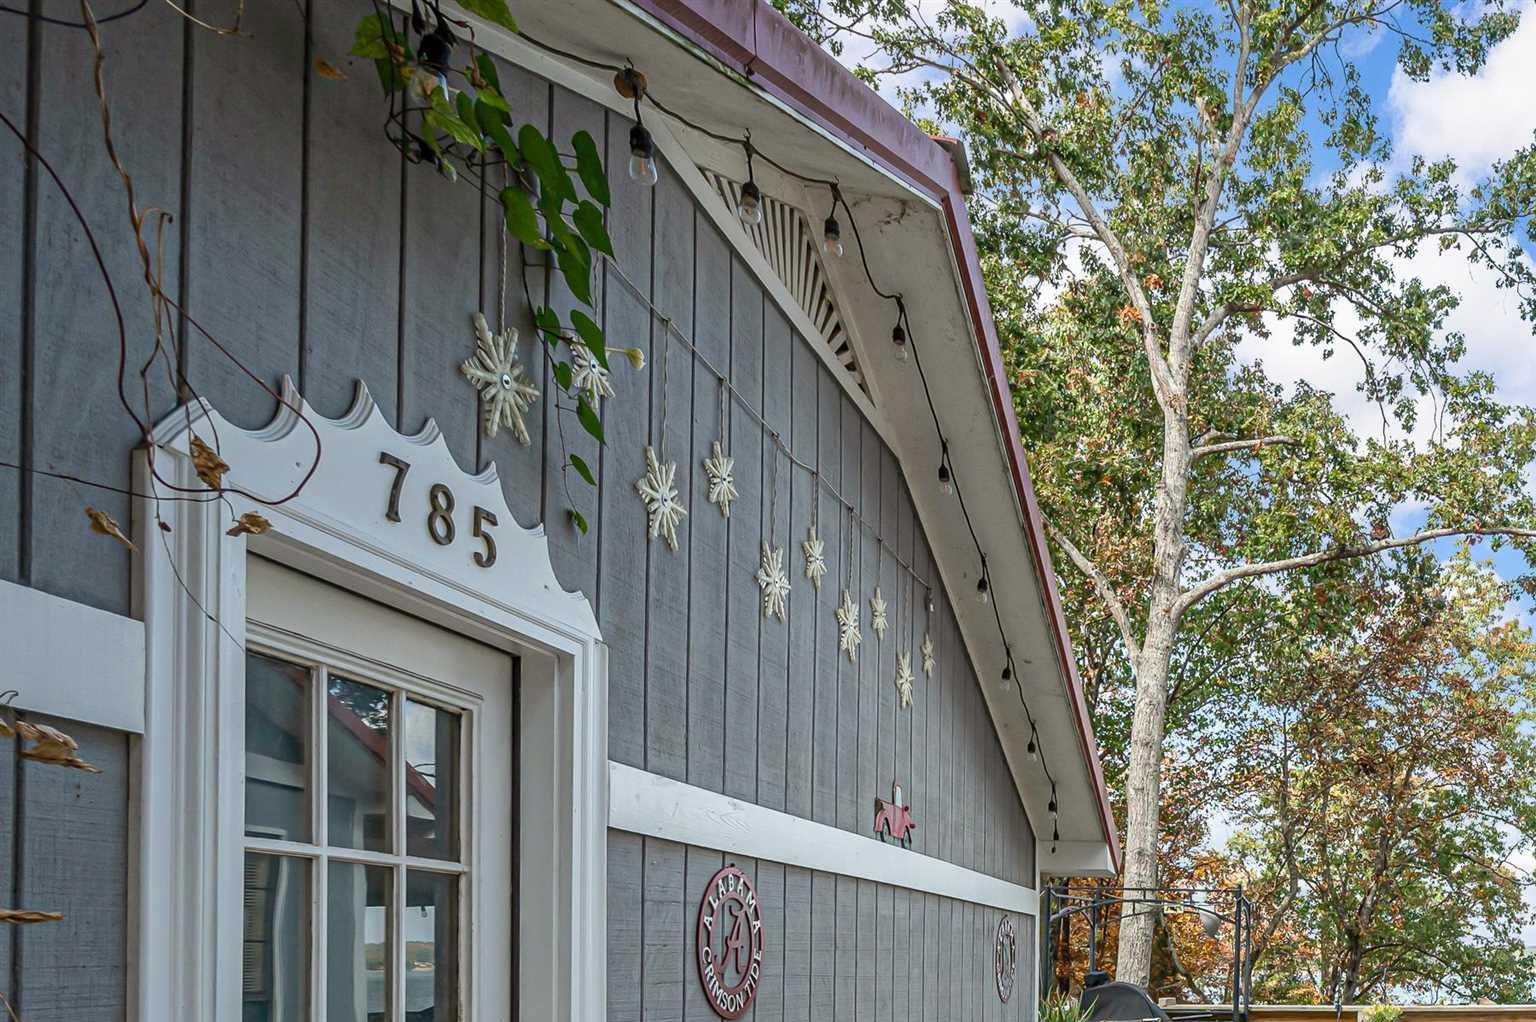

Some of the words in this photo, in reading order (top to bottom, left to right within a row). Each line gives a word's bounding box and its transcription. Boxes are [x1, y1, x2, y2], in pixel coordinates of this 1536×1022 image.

[379, 451, 499, 569] 785
[703, 873, 761, 934] ALABAMA
[714, 903, 748, 975] A
[703, 946, 744, 1012] CRIMSON
[744, 949, 762, 998] TIDE
